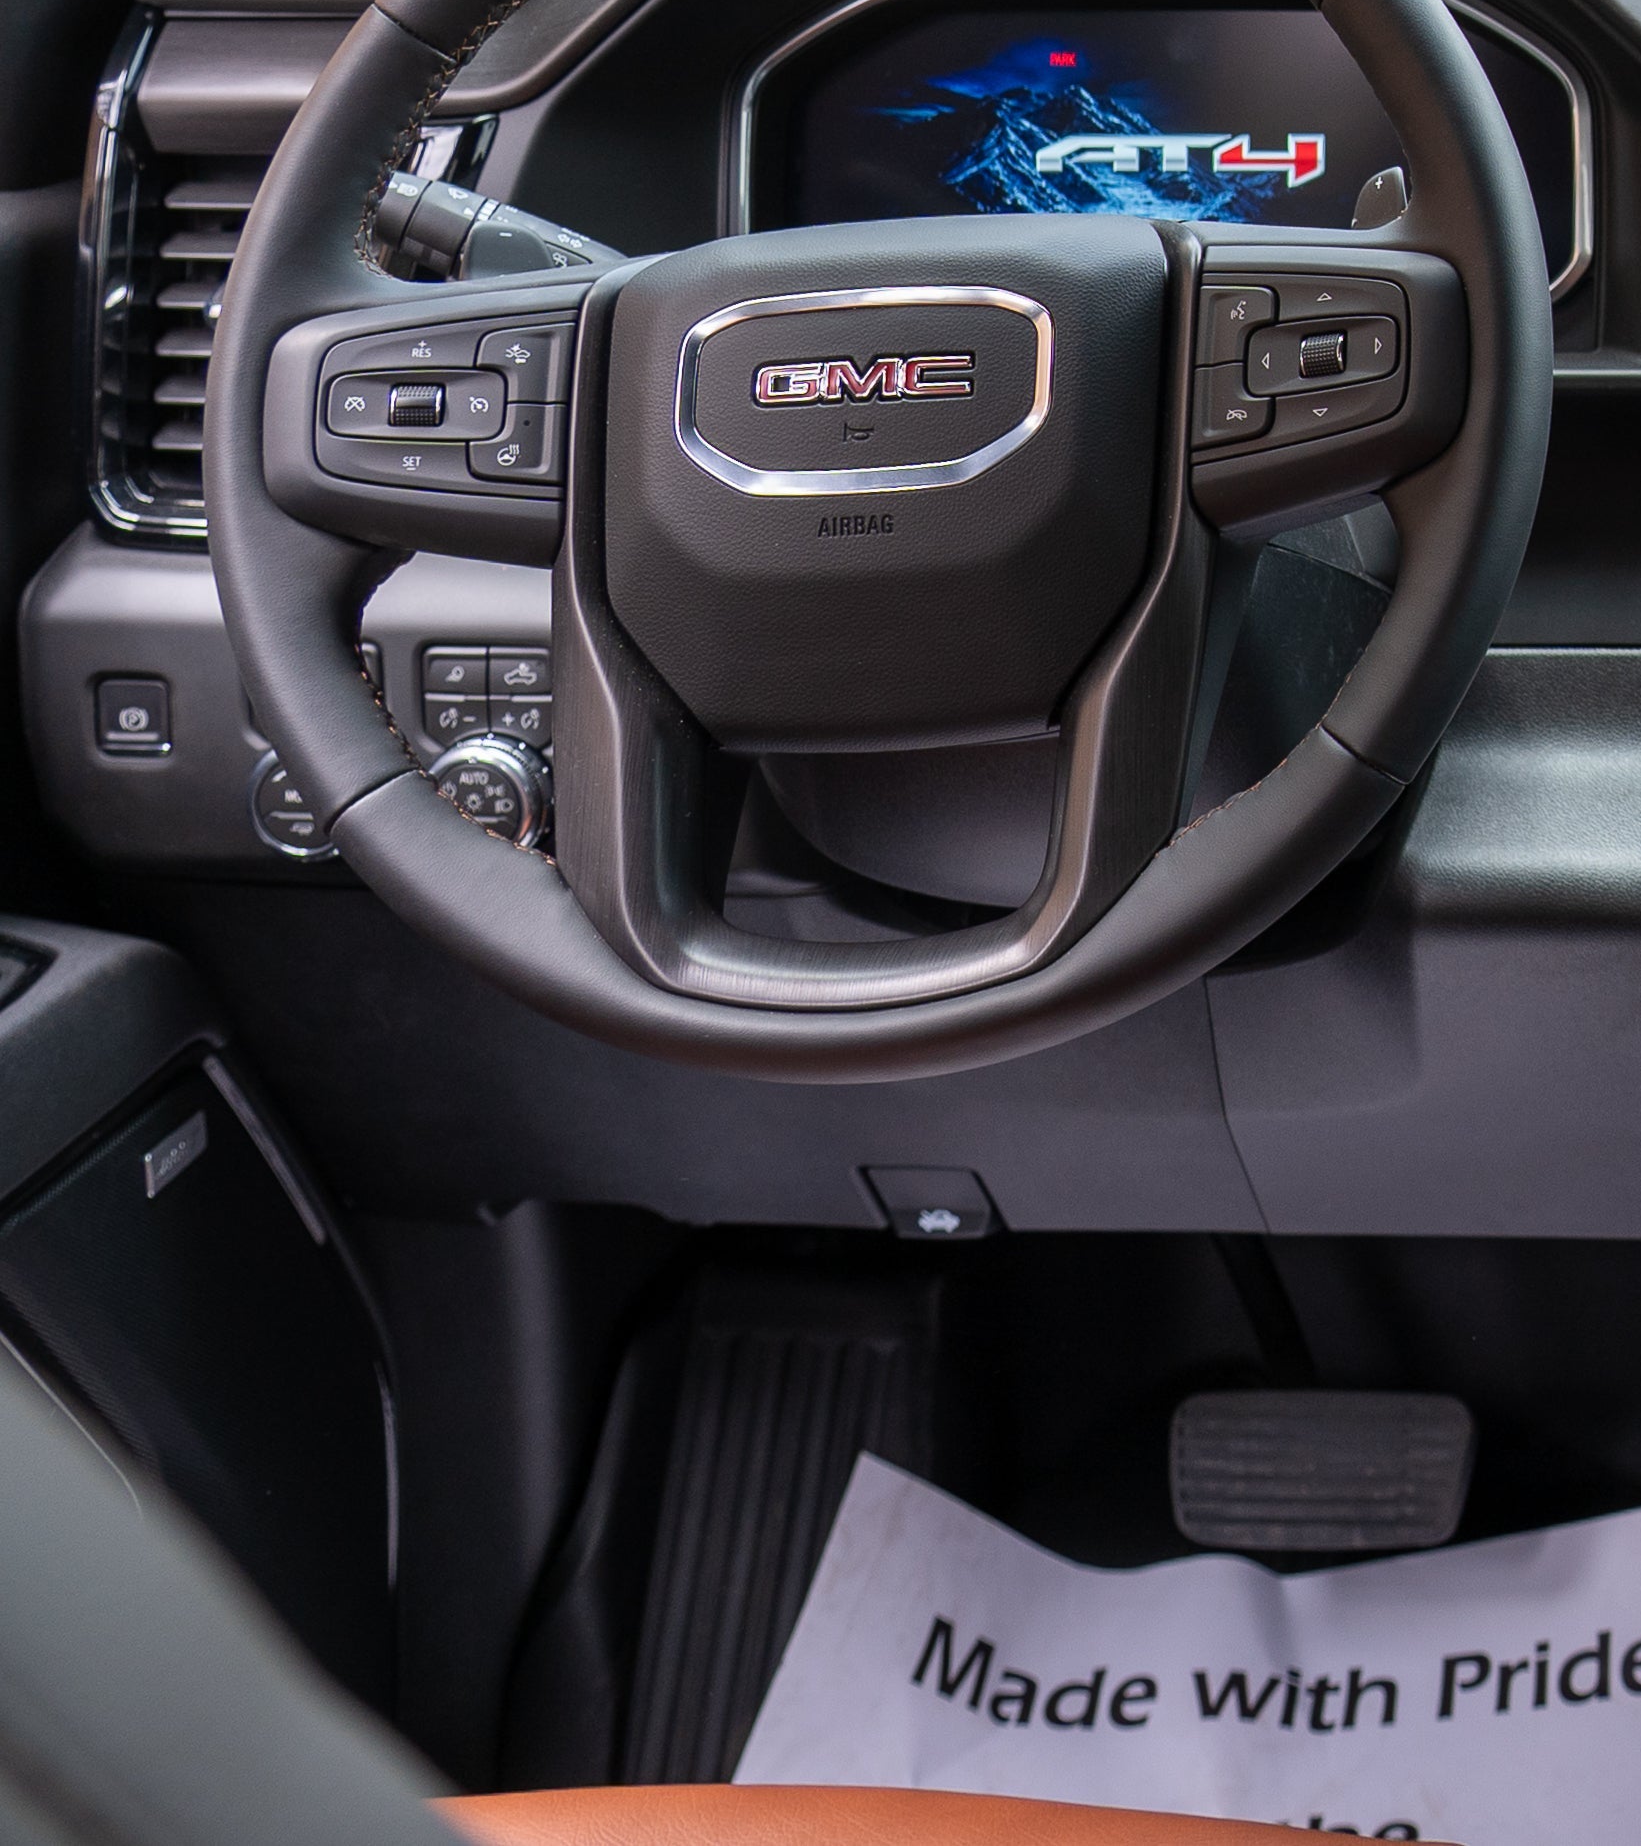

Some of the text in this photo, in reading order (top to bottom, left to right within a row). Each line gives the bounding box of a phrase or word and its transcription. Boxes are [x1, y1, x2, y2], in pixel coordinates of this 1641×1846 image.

[1050, 52, 1076, 67] PARK
[1035, 133, 1326, 188] AT4
[411, 348, 432, 358] RES
[755, 355, 972, 403] GMC
[402, 456, 422, 467] SET
[817, 514, 894, 538] AIRBAG
[459, 771, 489, 785] AUTO
[911, 1615, 1157, 1729] Made
[1193, 1666, 1398, 1733] with
